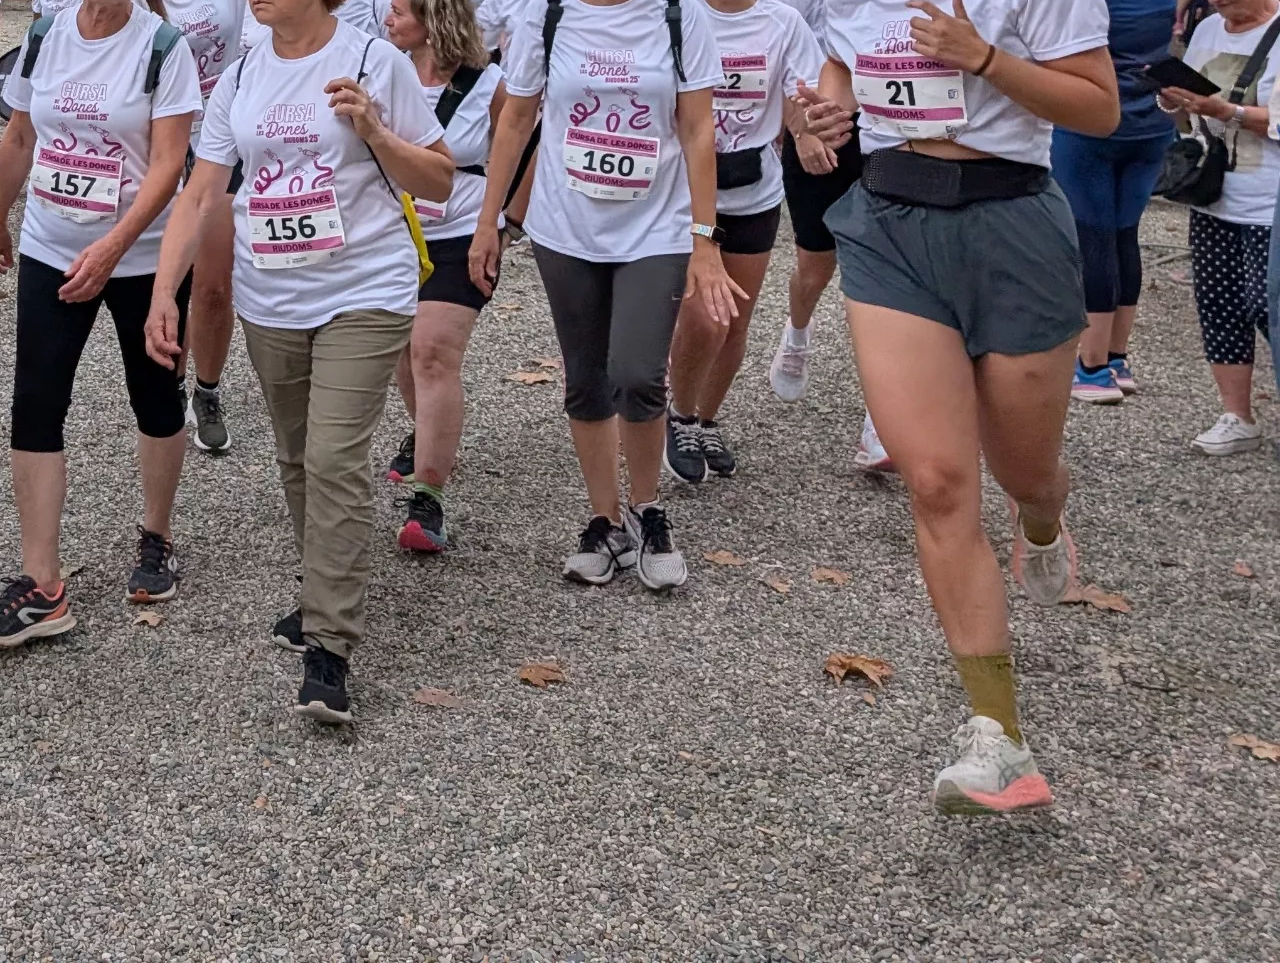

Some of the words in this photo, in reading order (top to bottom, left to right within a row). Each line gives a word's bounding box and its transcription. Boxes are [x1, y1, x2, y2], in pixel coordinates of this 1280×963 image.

[183, 19, 211, 36] Dones
[588, 62, 630, 77] Dones
[879, 62, 892, 70] DE
[895, 61, 915, 70] LES
[916, 61, 946, 69] DON
[61, 80, 108, 101] CURSA
[885, 80, 916, 106] 21
[61, 98, 100, 113] Dones
[264, 103, 316, 123] CURSA
[266, 122, 309, 138] Dones
[570, 132, 595, 143] CURSA
[597, 137, 608, 145] DE
[610, 139, 626, 147] LES
[627, 142, 655, 151] DONES
[73, 160, 88, 168] LES
[88, 162, 117, 172] DONES
[582, 150, 635, 177] 160
[50, 171, 97, 198] 157
[584, 174, 625, 187] RIUDOMS
[283, 200, 299, 209] LES
[300, 195, 331, 206] DONES
[265, 215, 316, 241] 156
[272, 242, 312, 252] RIUDOMS
